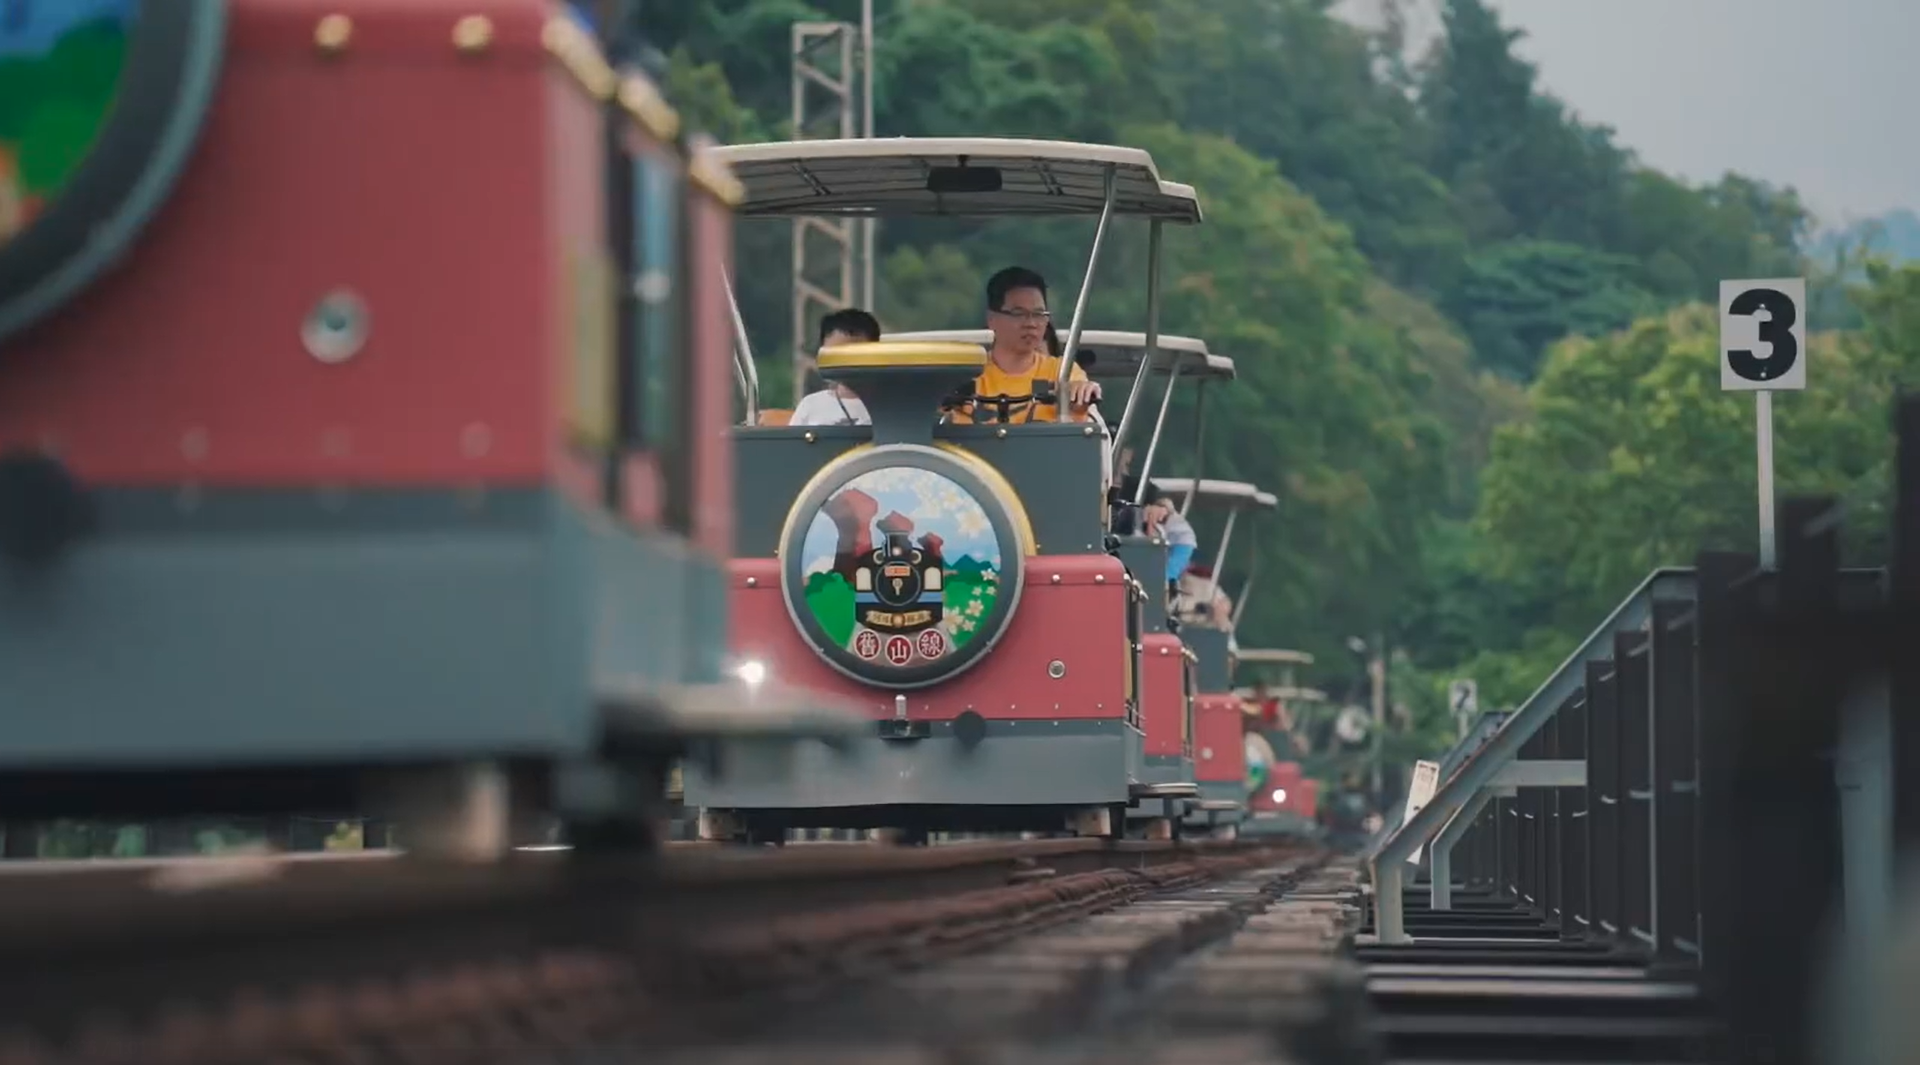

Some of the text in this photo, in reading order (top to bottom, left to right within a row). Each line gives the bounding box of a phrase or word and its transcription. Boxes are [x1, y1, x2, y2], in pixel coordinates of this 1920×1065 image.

[1727, 288, 1798, 382] 3
[857, 631, 942, 661] 舊山線
